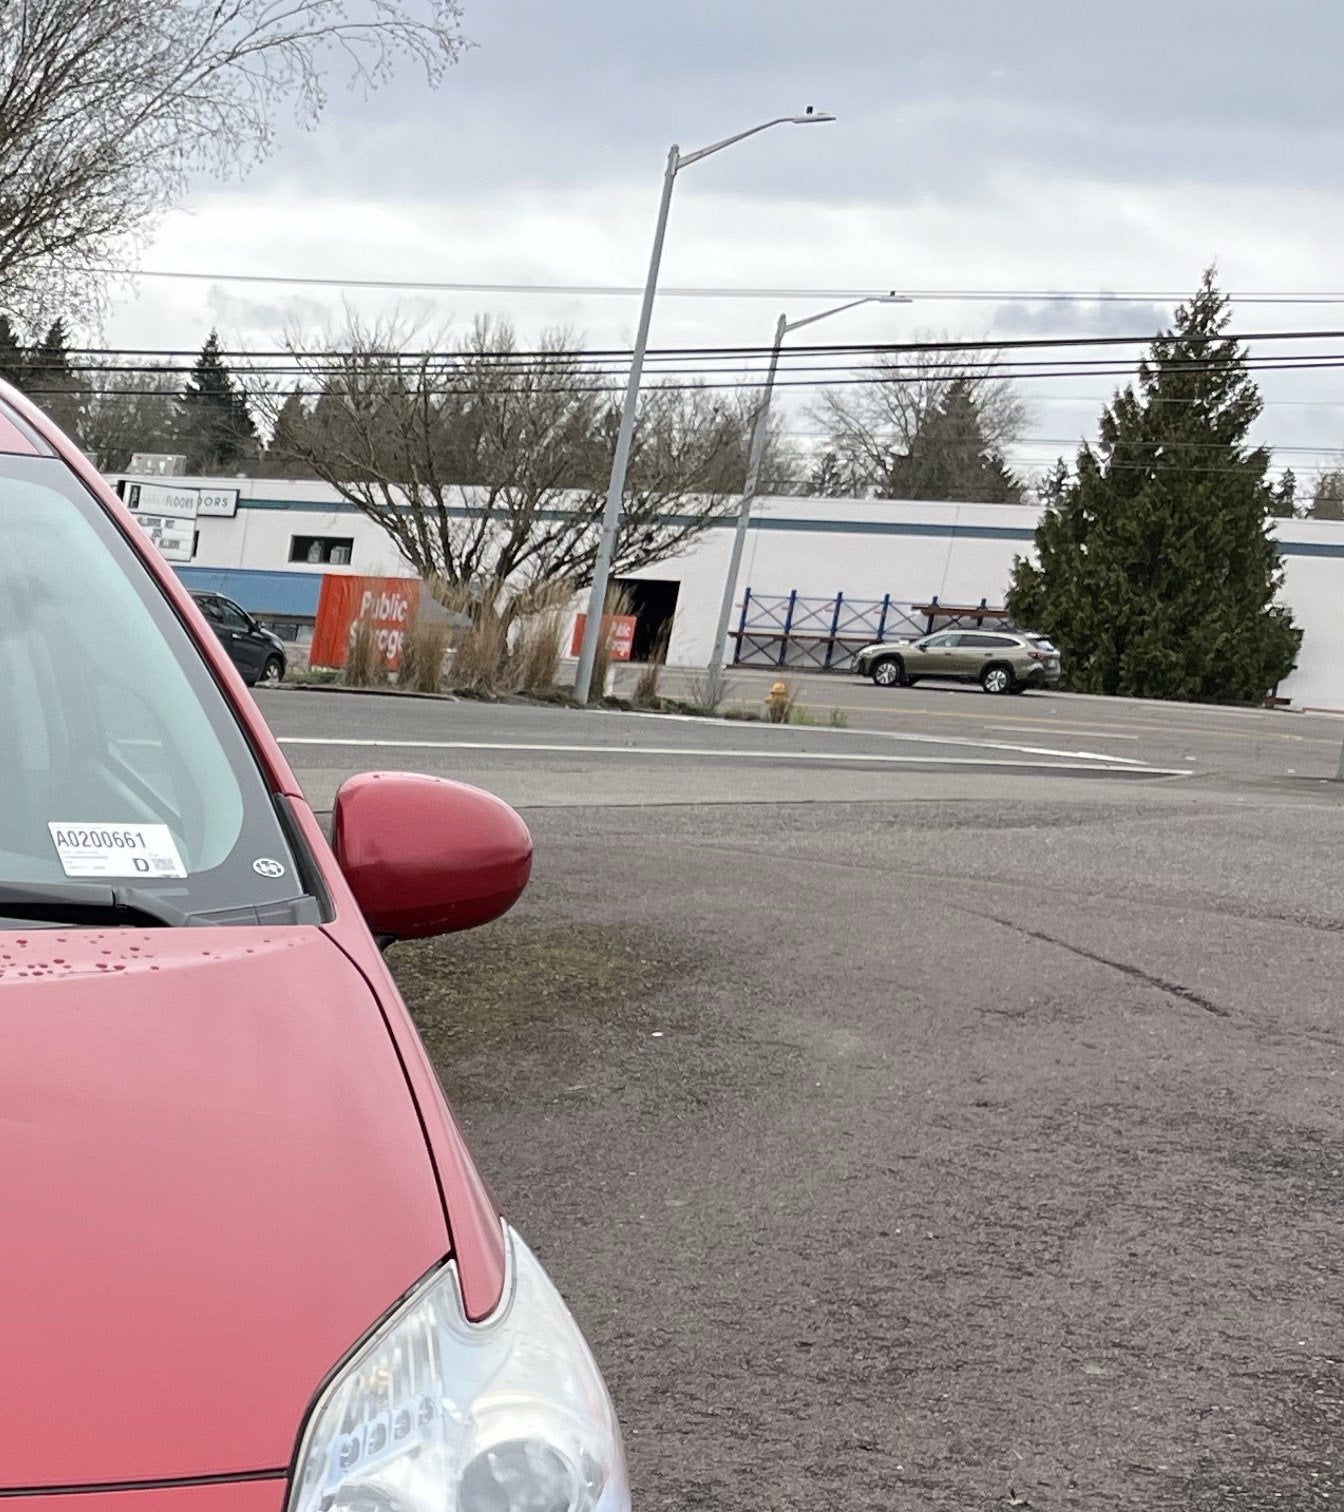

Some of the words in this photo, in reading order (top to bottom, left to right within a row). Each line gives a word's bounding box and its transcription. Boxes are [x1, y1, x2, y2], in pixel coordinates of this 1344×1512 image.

[359, 590, 408, 622] Public
[56, 830, 147, 849] A0200661
[132, 857, 150, 872] D
